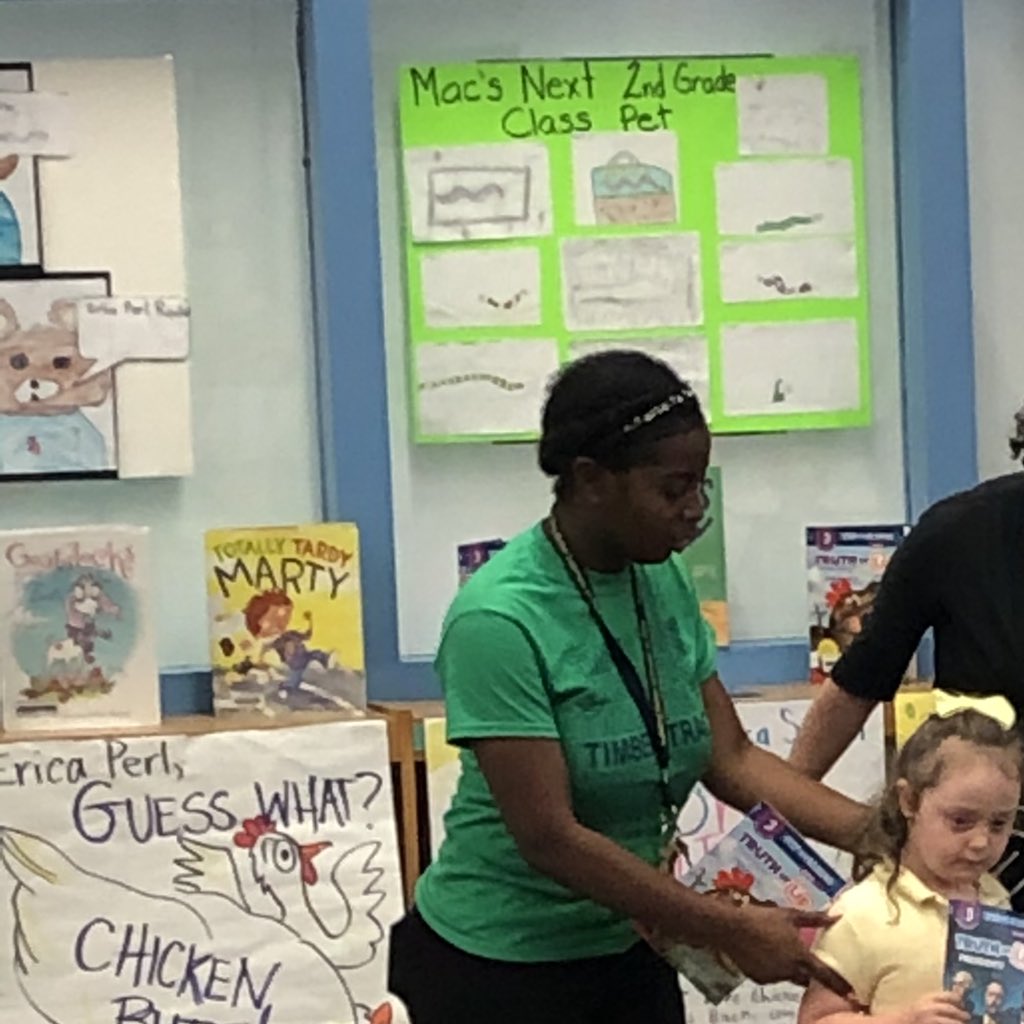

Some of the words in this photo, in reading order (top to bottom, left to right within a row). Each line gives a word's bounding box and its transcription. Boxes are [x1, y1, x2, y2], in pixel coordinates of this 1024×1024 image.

[410, 66, 503, 107] Mac's
[520, 60, 594, 103] Next
[622, 59, 666, 100] 2nd
[673, 62, 737, 95] Grade
[501, 106, 593, 138] Class
[620, 103, 673, 132] Pet
[213, 537, 286, 562] TOTALLY
[292, 537, 353, 568] TARDY
[213, 556, 350, 600] MARTY
[105, 740, 186, 780] Perl,
[583, 731, 658, 769] TIMBE
[72, 780, 238, 844] GUESS
[254, 771, 384, 833] WHAT?
[75, 917, 282, 1010] CHICKEN
